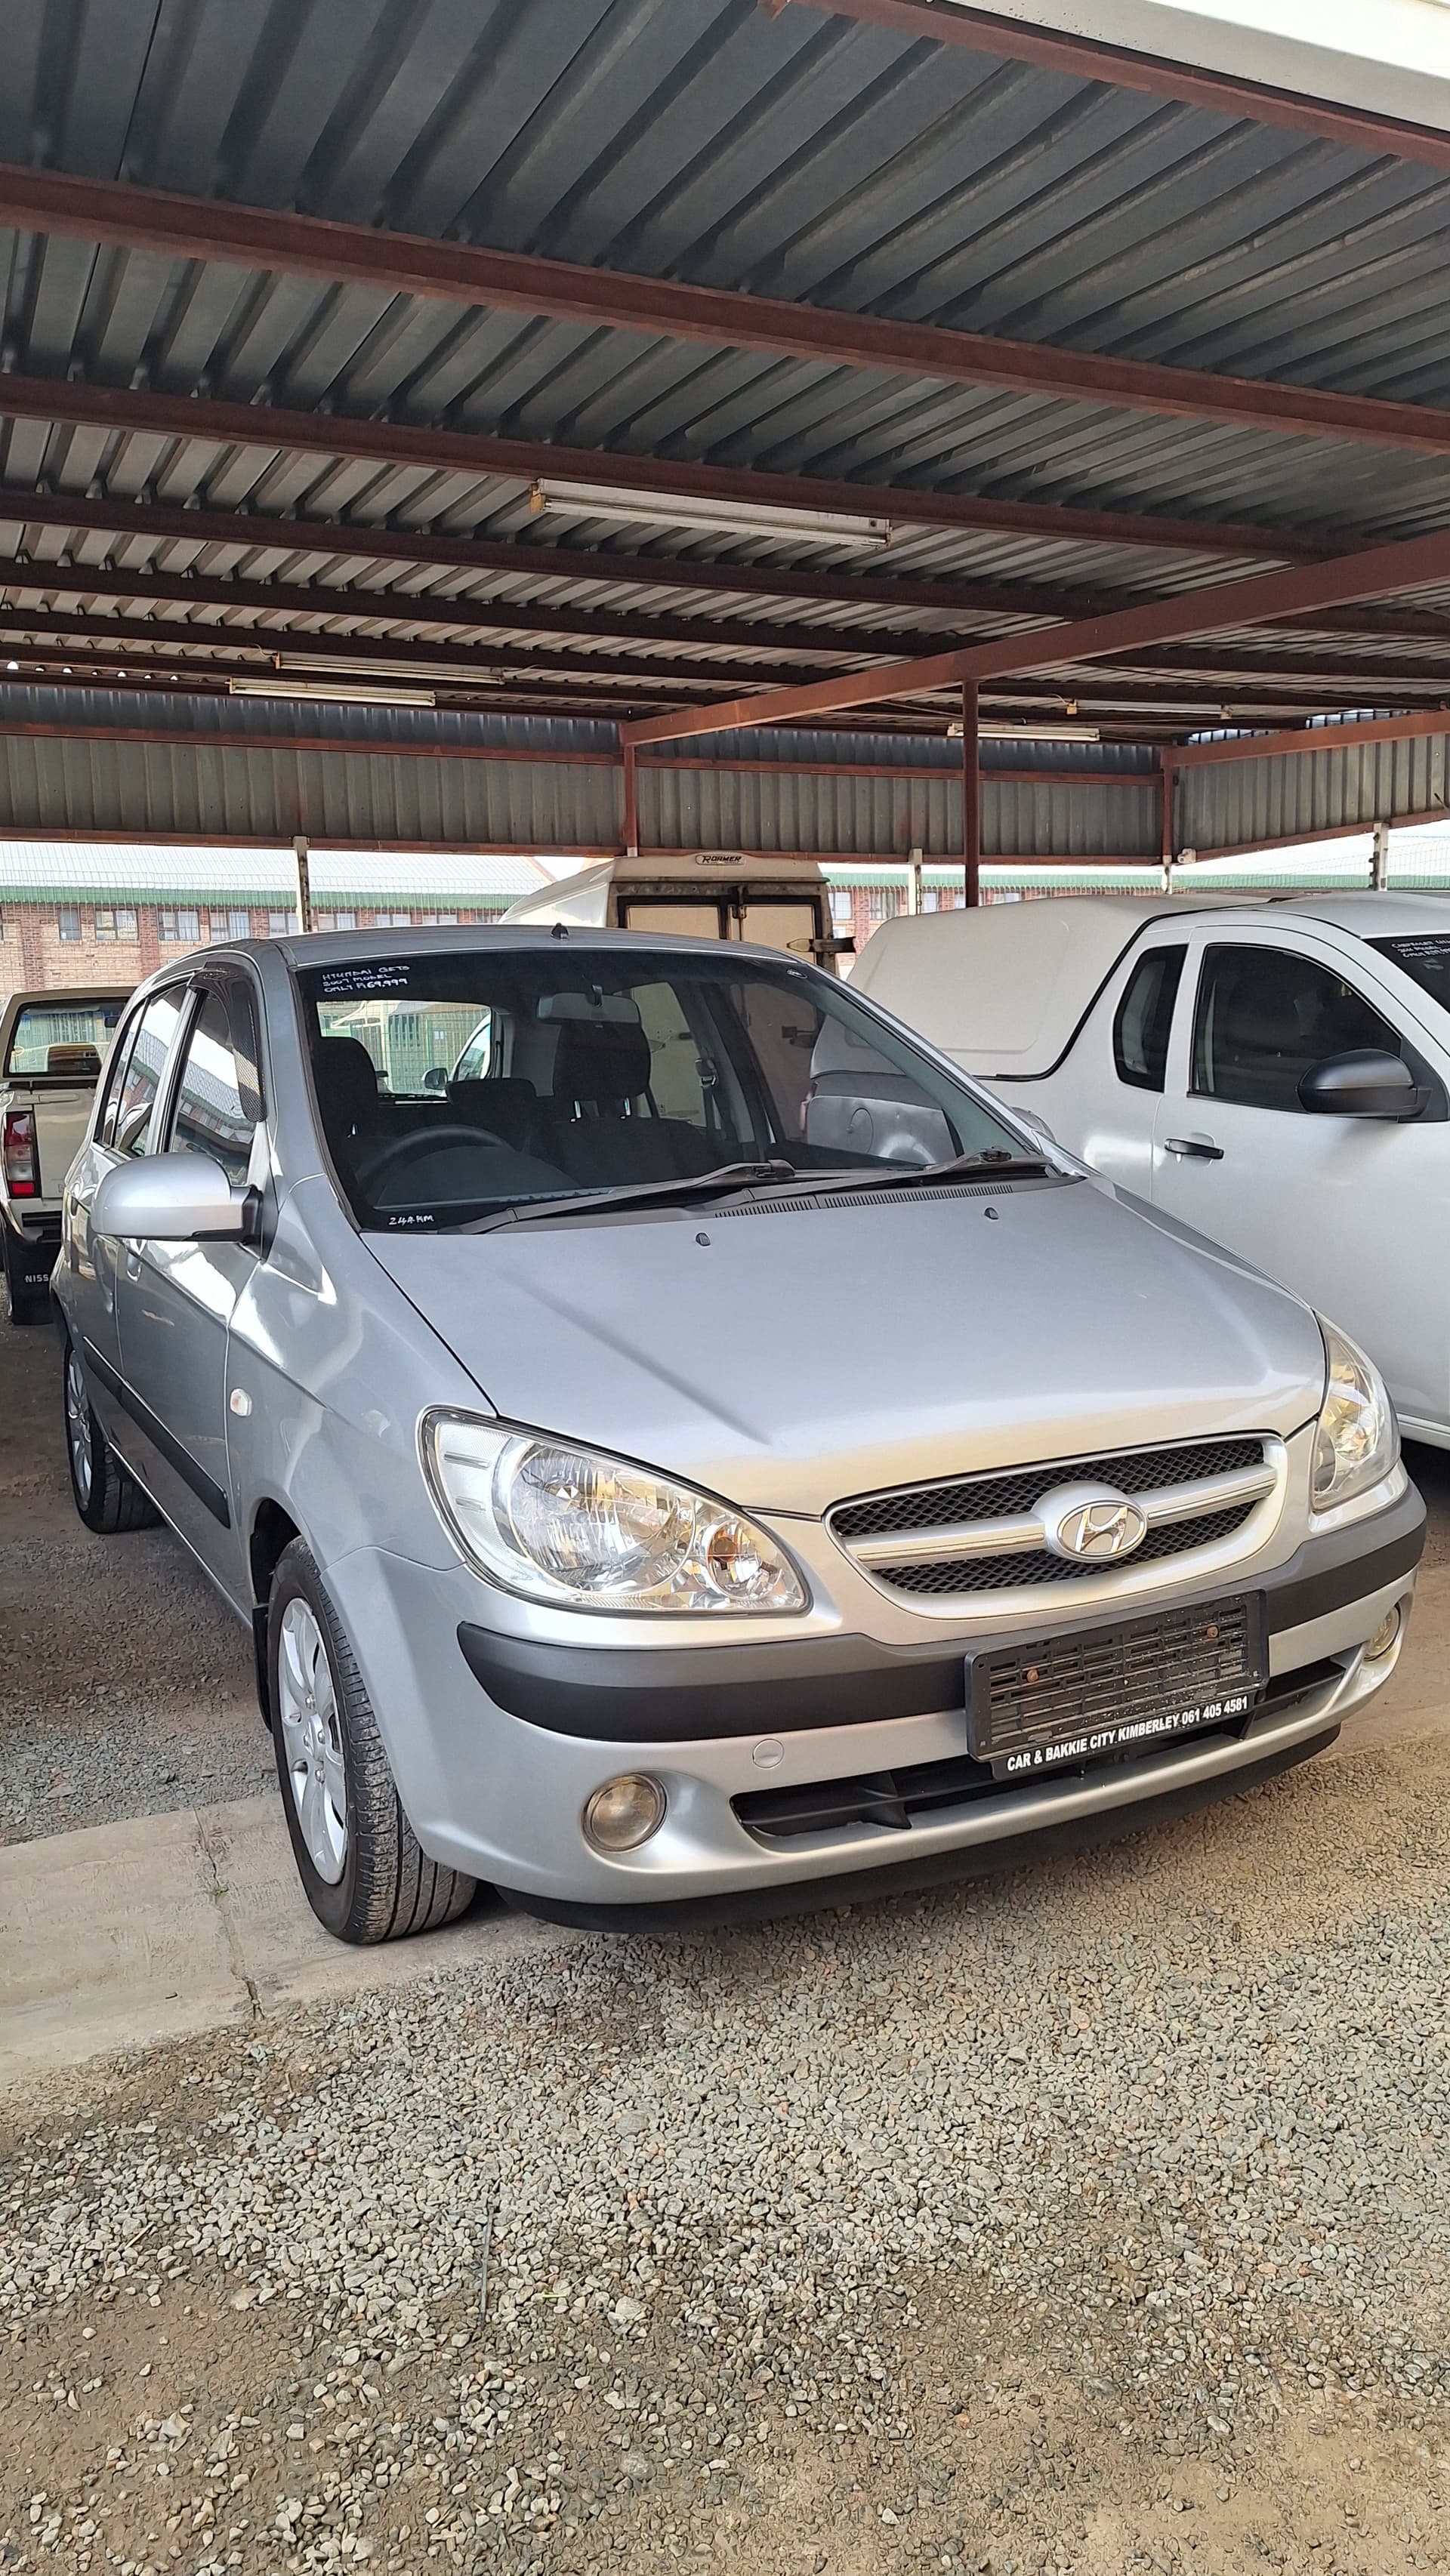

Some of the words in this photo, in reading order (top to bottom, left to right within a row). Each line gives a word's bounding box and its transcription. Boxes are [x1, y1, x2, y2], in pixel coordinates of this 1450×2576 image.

[322, 969, 372, 981] HYUNDAI
[324, 984, 353, 993] ONLY
[25, 1274, 49, 1283] NISS
[1007, 1752, 1032, 1771] CAR
[1034, 1749, 1043, 1764] &
[1045, 1737, 1088, 1762] BAKKIE
[1090, 1730, 1117, 1749] CITY
[1118, 1712, 1180, 1742] KIMBERLEY
[1182, 1709, 1201, 1725] 061
[1202, 1703, 1222, 1720] 405
[1223, 1696, 1248, 1715] 4581
